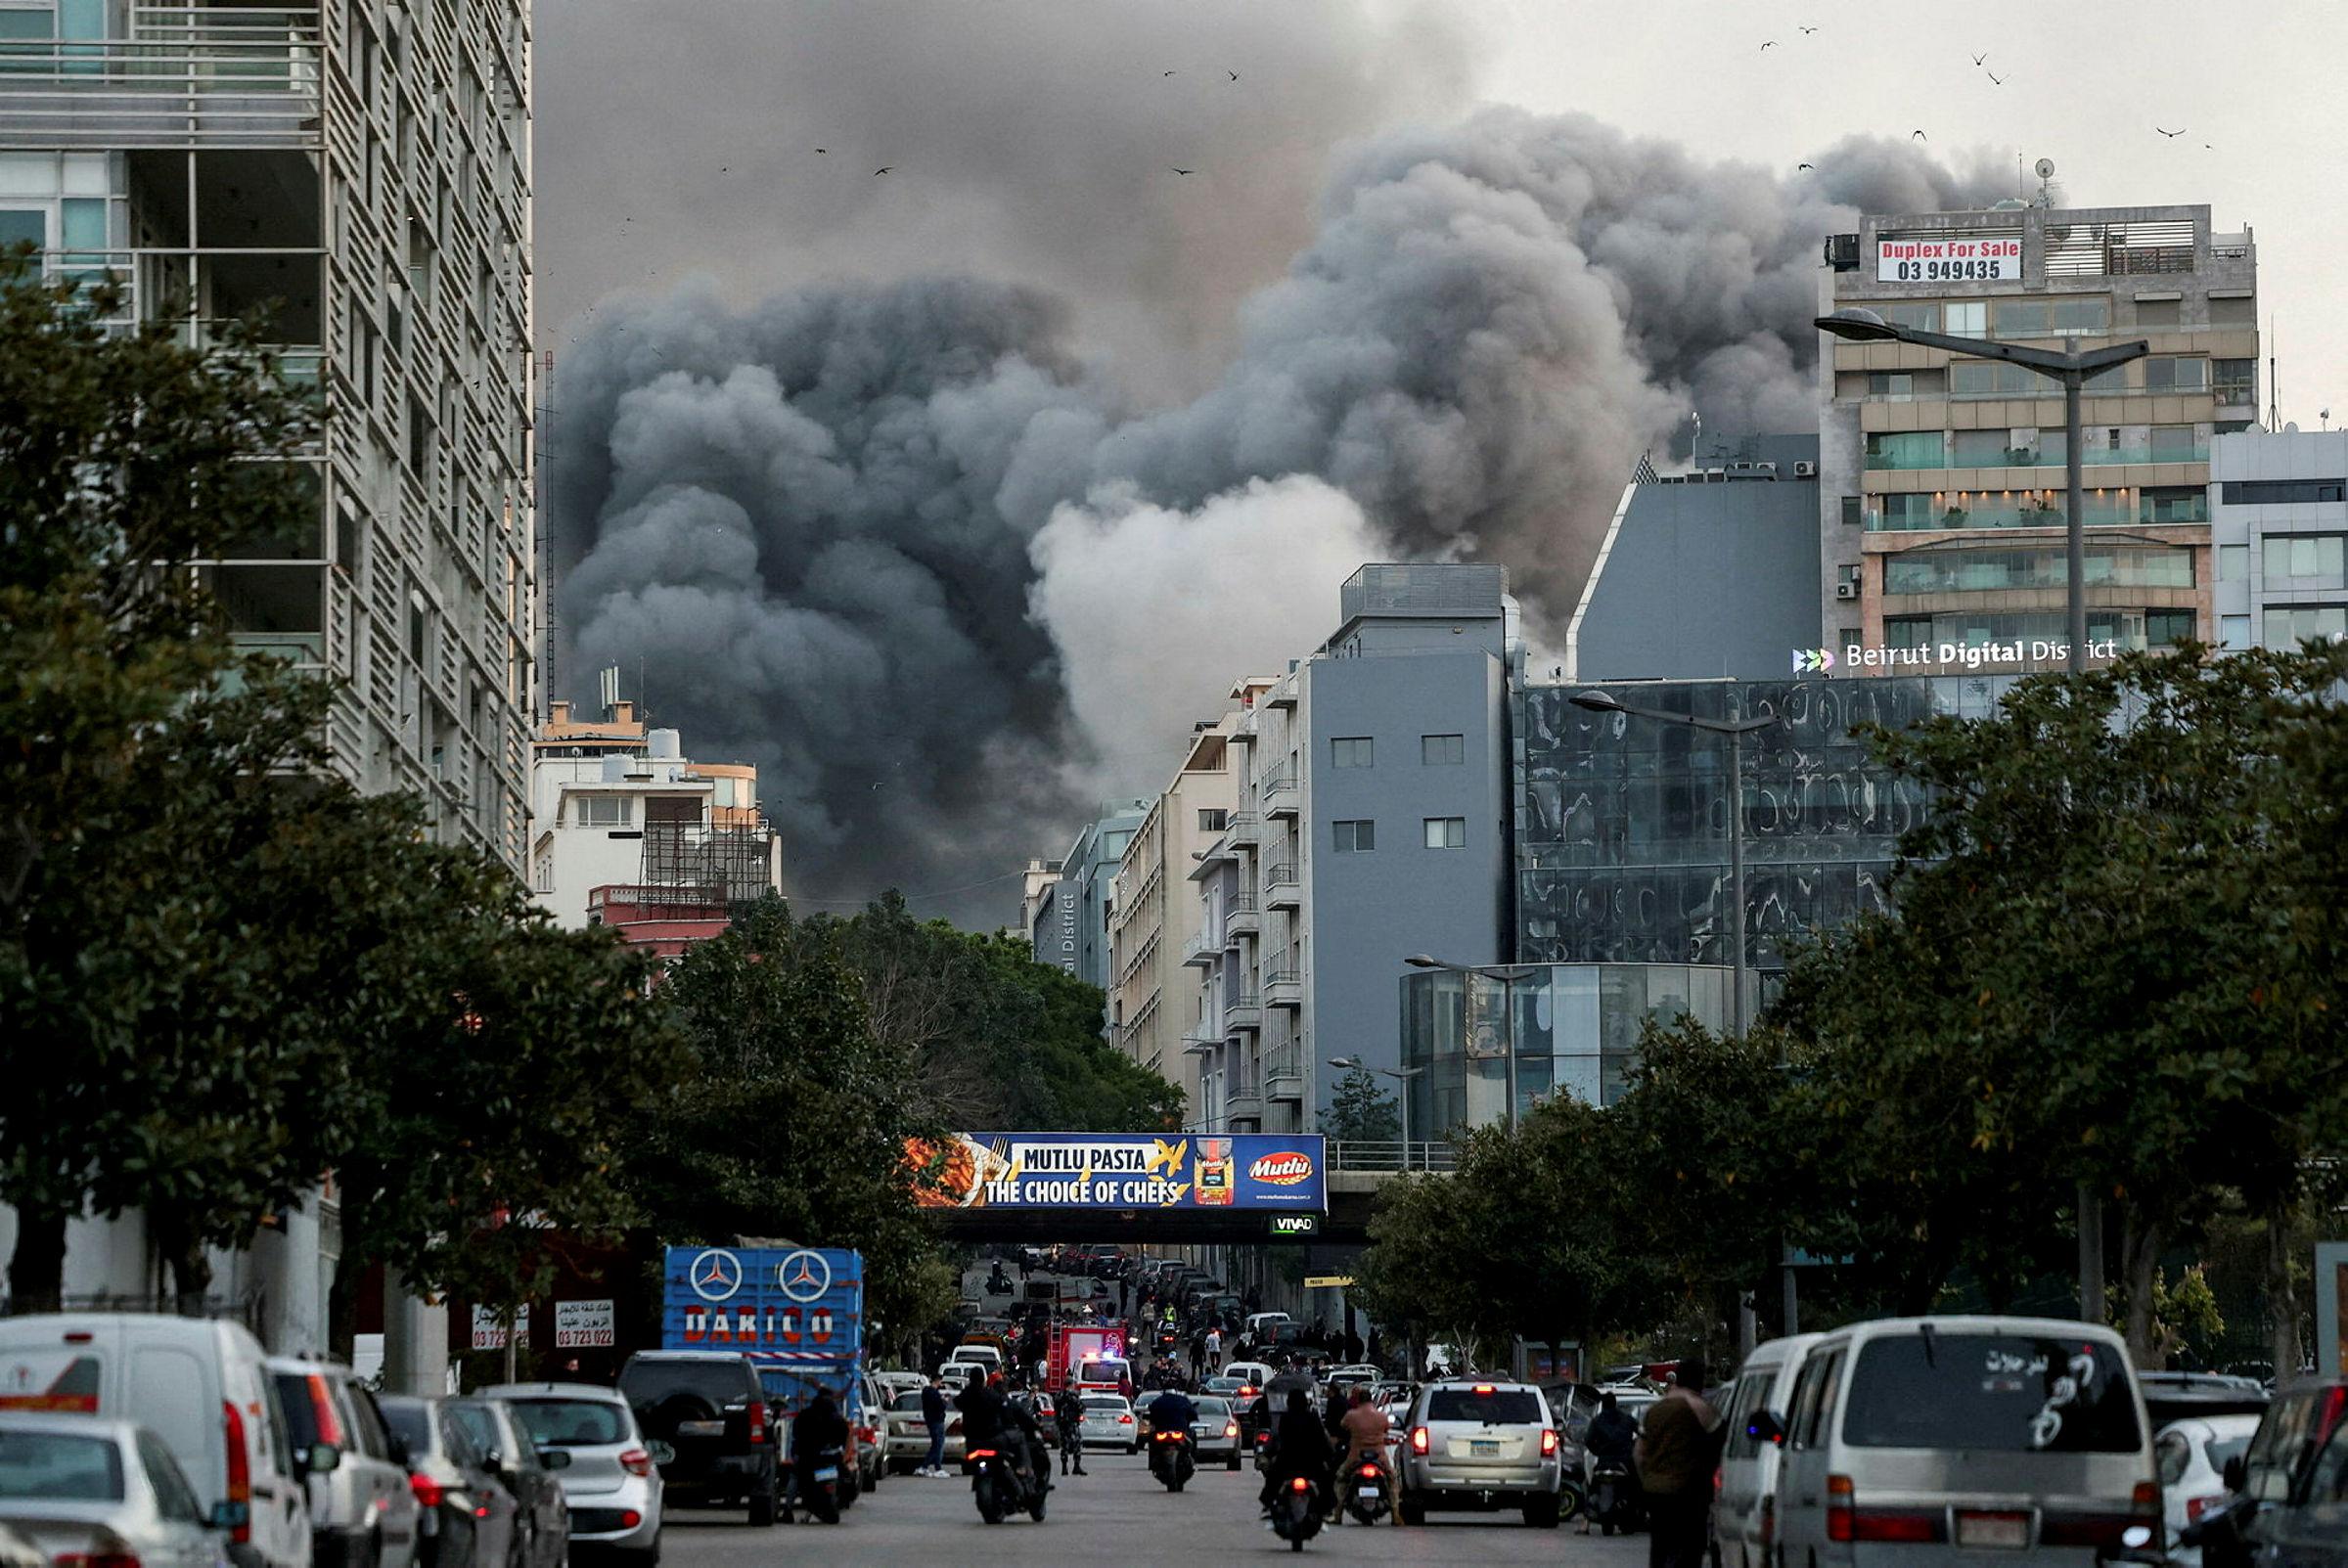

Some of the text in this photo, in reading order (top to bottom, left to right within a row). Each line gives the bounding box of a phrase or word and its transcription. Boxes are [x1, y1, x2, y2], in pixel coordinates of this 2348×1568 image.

[1882, 241, 2019, 261] Duplex For Sale
[1898, 260, 2001, 281] 03 949435
[1846, 638, 2117, 669] Beirut Digital Disict
[1061, 893, 1075, 952] District
[1023, 1148, 1147, 1170] MUTLU PASTA
[1248, 1156, 1309, 1178] Mutlu
[985, 1181, 1179, 1204] THE CHOICE OF CHEFS
[474, 1331, 485, 1347] 03
[558, 1329, 612, 1346] 03 723 022
